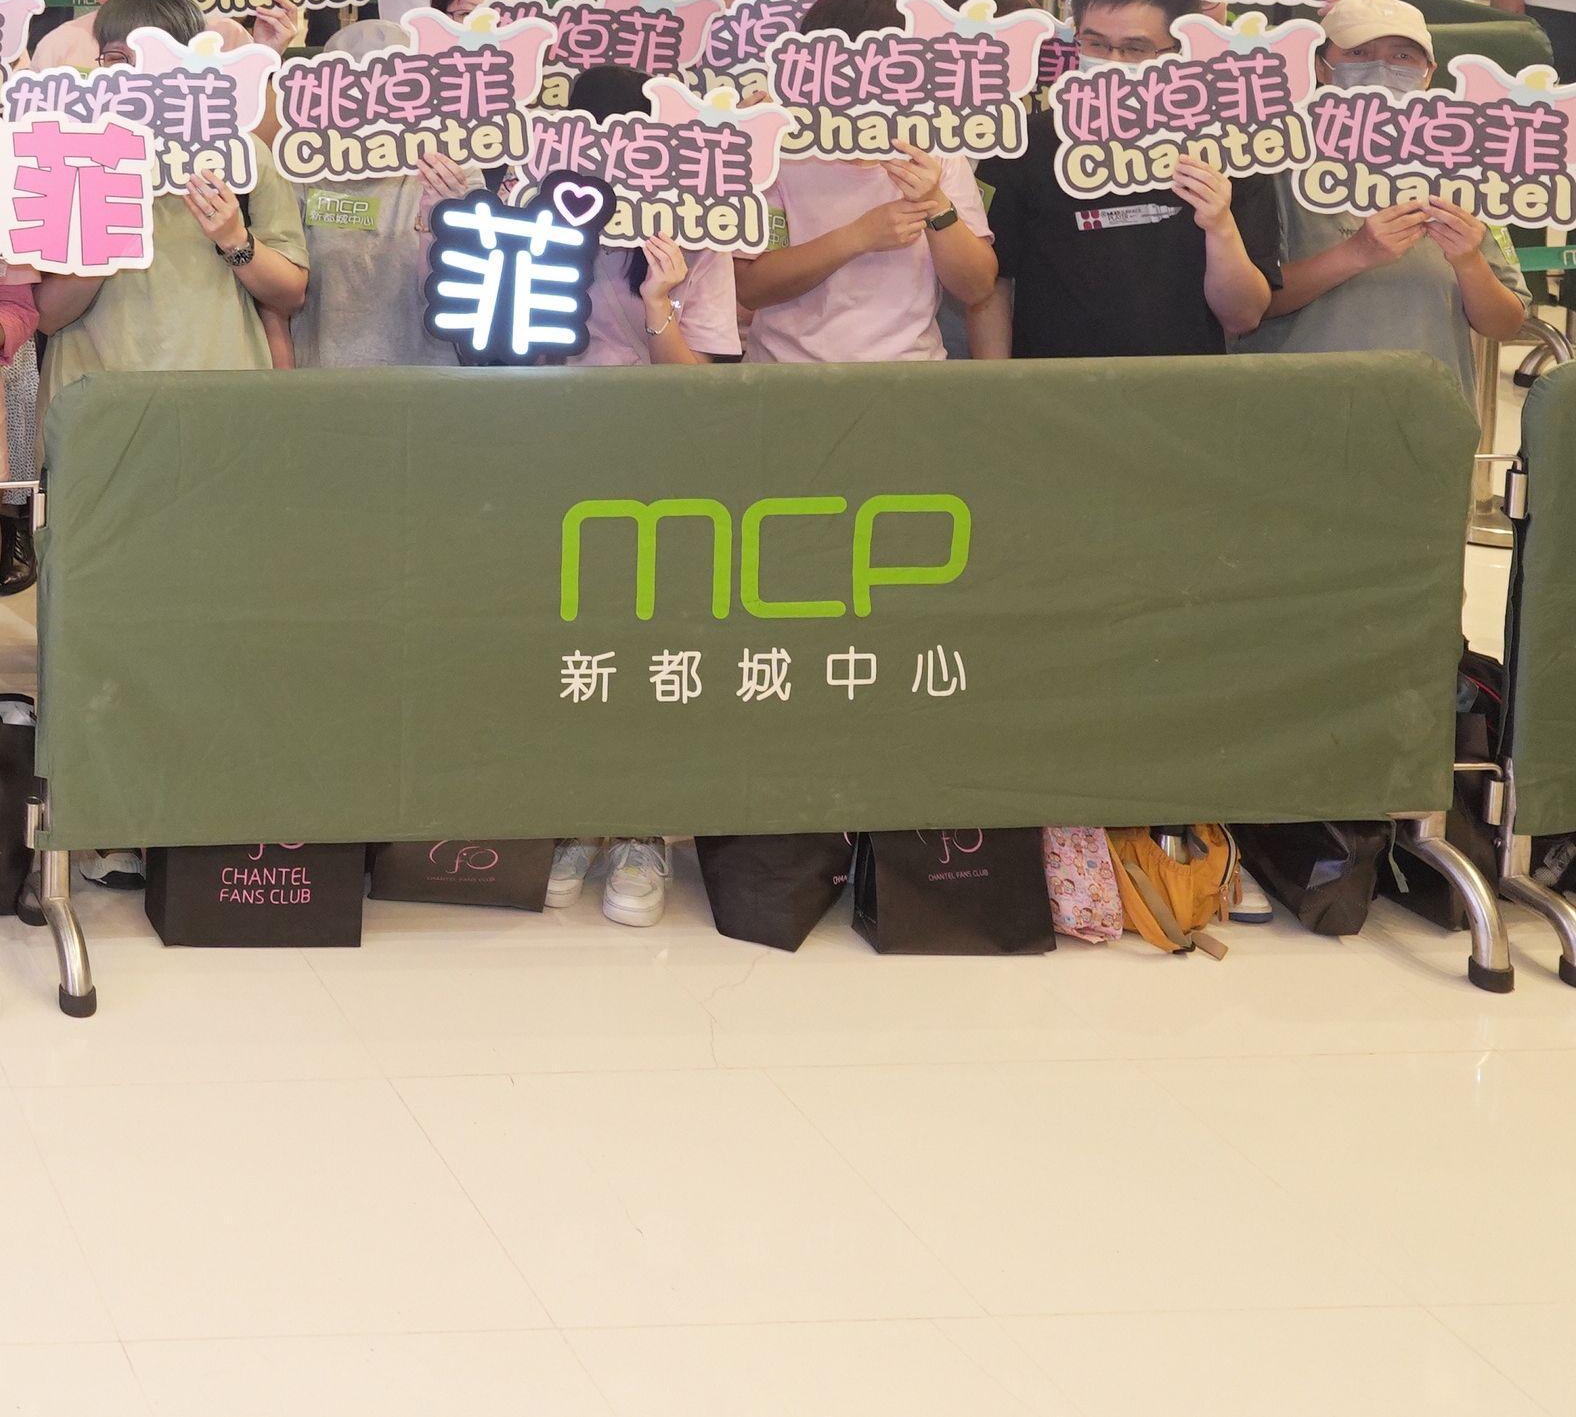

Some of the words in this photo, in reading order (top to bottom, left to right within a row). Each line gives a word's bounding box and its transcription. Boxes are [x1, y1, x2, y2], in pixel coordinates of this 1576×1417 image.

[286, 52, 511, 129] 姚焯菲
[779, 38, 1003, 106] 姚焯菲
[1063, 54, 1286, 143] 姚焯菲
[284, 112, 527, 180] Chantel
[781, 102, 1017, 151] Chantel
[1068, 116, 1307, 188] Chantel
[1314, 99, 1566, 174] 姚焯菲
[1304, 162, 1576, 219] Chantel
[435, 201, 584, 355] 菲
[560, 644, 967, 704] 新都城中心
[219, 888, 265, 905] FANS
[270, 888, 312, 905] CLUB
[221, 867, 312, 886] CHANTEL
[928, 871, 955, 882] CHANTEL
[956, 870, 972, 880] FANS
[972, 869, 989, 879] CLUB
